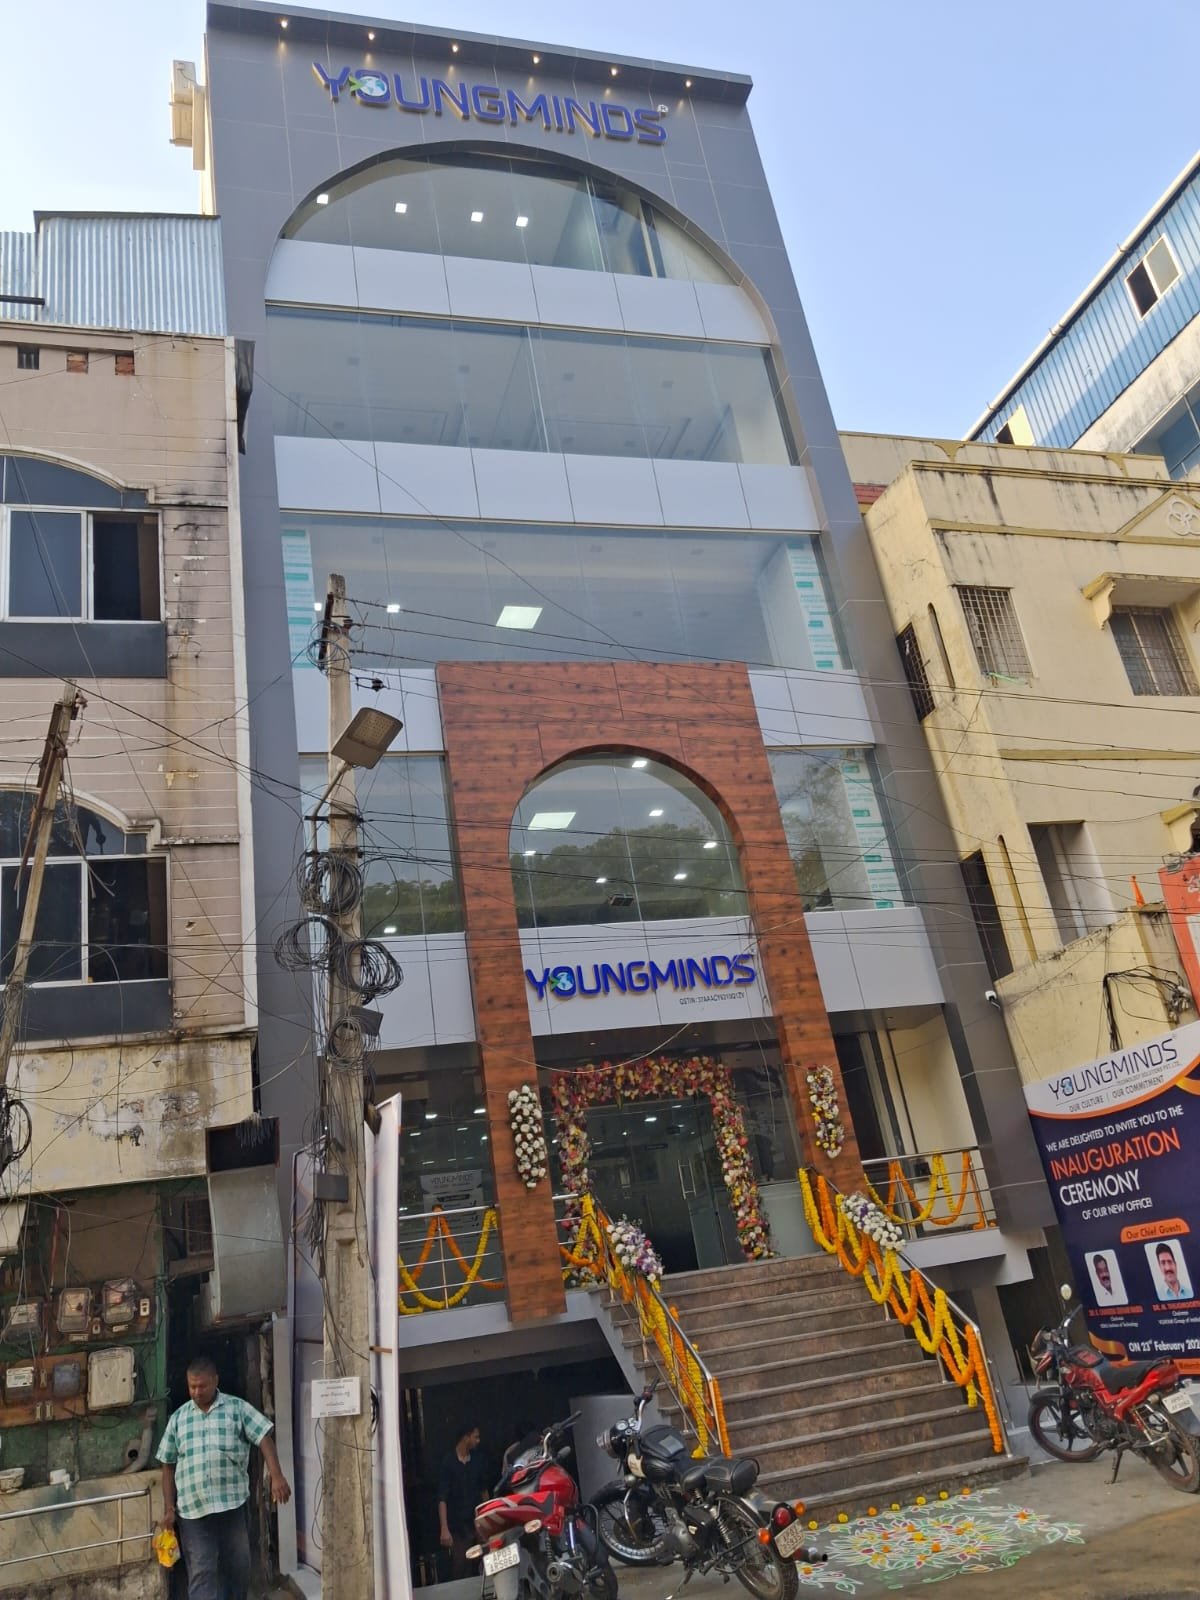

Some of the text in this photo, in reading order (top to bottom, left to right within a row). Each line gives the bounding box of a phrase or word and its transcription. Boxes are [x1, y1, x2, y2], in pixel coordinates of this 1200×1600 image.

[312, 62, 666, 145] YOUNGMINDS
[526, 954, 756, 1000] YOUNGMINDS
[1048, 1038, 1178, 1100] YOUNGMINDS
[1081, 1095, 1104, 1109] CULTURE
[1112, 1089, 1125, 1098] OUR
[1126, 1075, 1164, 1094] COMMITMENT
[1045, 1105, 1184, 1152] WE ARE DELIGHTED TO INVITE YOU TO THE
[1050, 1127, 1181, 1180] INAUGURATION
[1060, 1168, 1140, 1206] CEREMONY
[1082, 1209, 1091, 1220] OF
[1092, 1206, 1108, 1218] OUR
[1108, 1202, 1125, 1215] NEW
[1126, 1223, 1182, 1239] Our Chief Guests
[1128, 1342, 1141, 1352] ON
[1153, 1340, 1185, 1352] February
